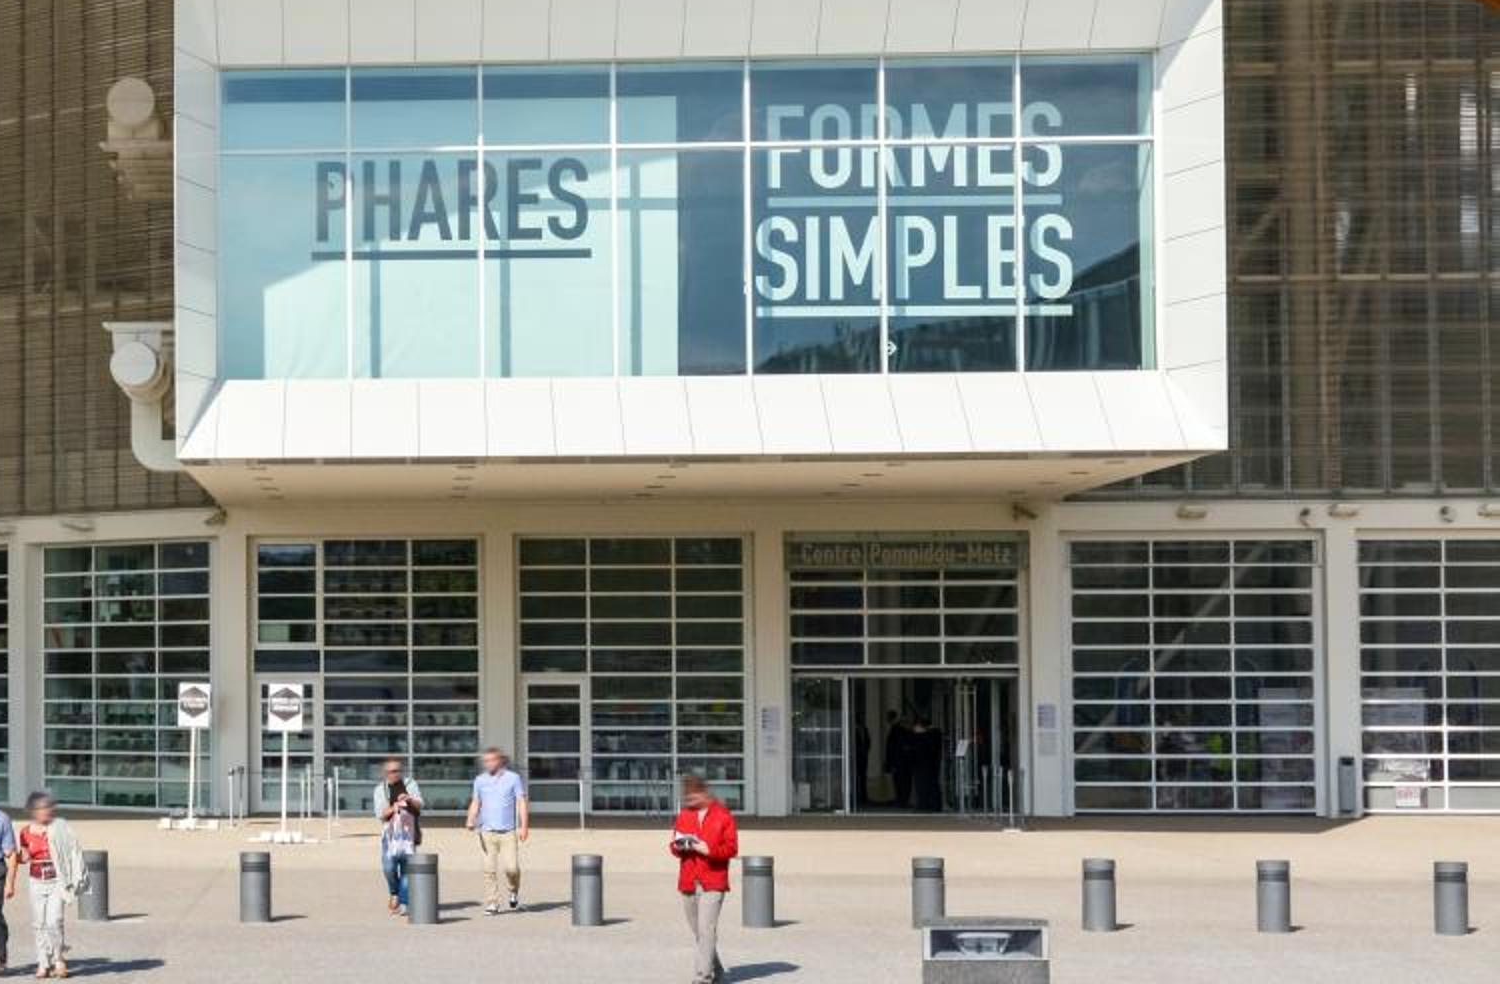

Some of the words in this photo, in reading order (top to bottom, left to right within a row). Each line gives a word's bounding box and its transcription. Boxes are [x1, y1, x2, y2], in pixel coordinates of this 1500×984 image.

[766, 101, 1063, 189] FORMES
[315, 157, 590, 243] PHARES
[755, 214, 1074, 301] SIMPLES
